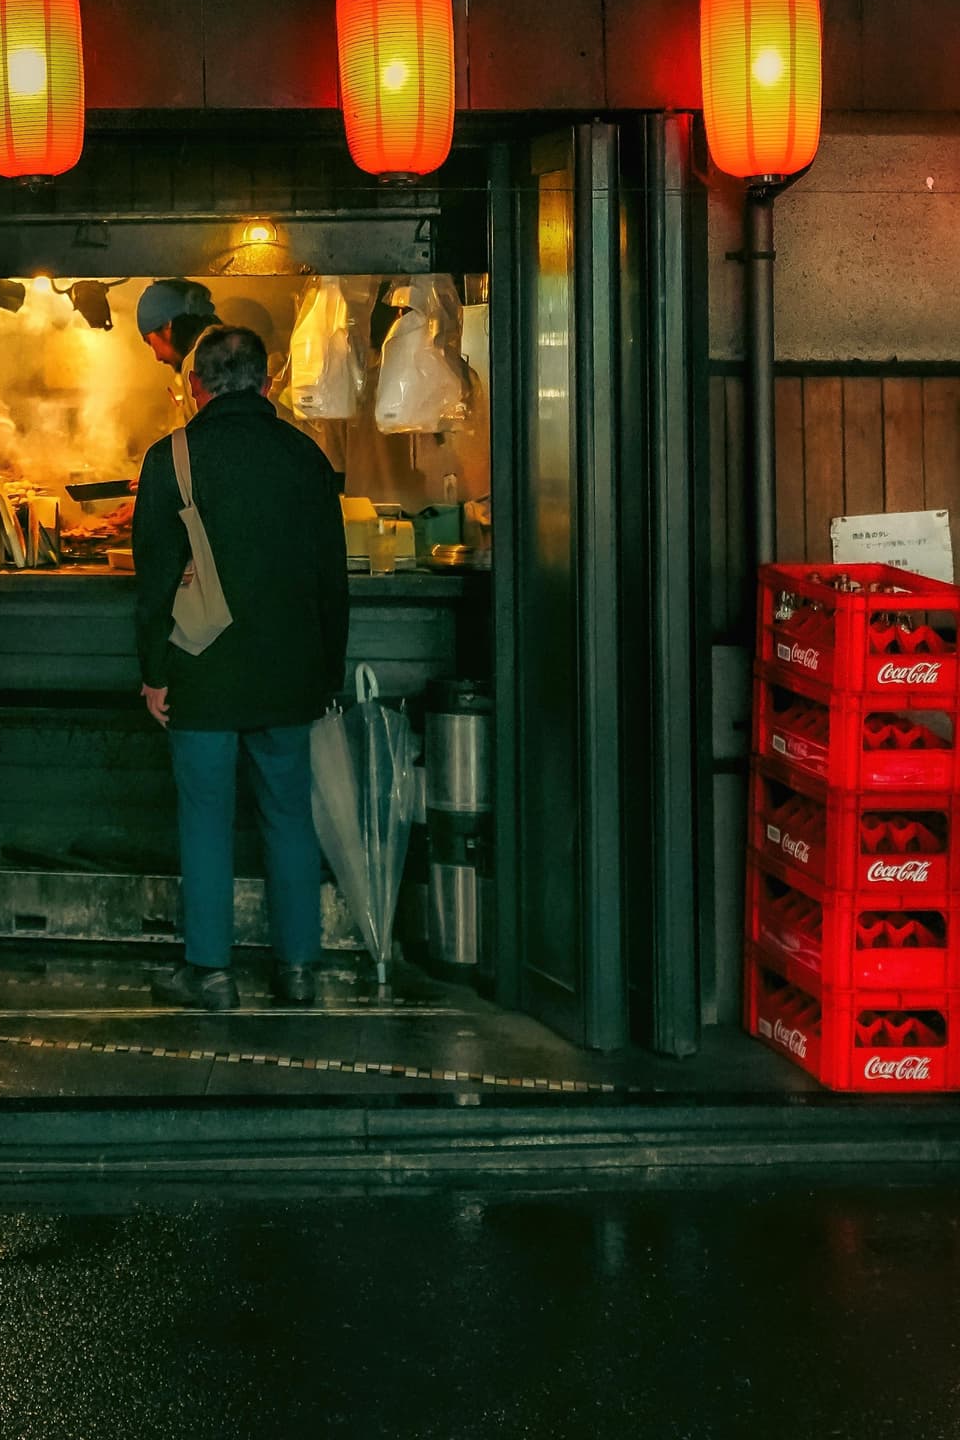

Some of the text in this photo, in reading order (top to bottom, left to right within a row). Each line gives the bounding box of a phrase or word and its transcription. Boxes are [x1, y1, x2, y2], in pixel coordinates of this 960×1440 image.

[791, 643, 819, 671] Coca-Cola
[877, 662, 942, 685] Coca-Cola
[781, 833, 810, 864] Coca-Cola
[868, 861, 930, 882] Coca-Cola
[773, 1018, 807, 1059] Coca-Cola
[865, 1056, 930, 1080] Coca-Cola
